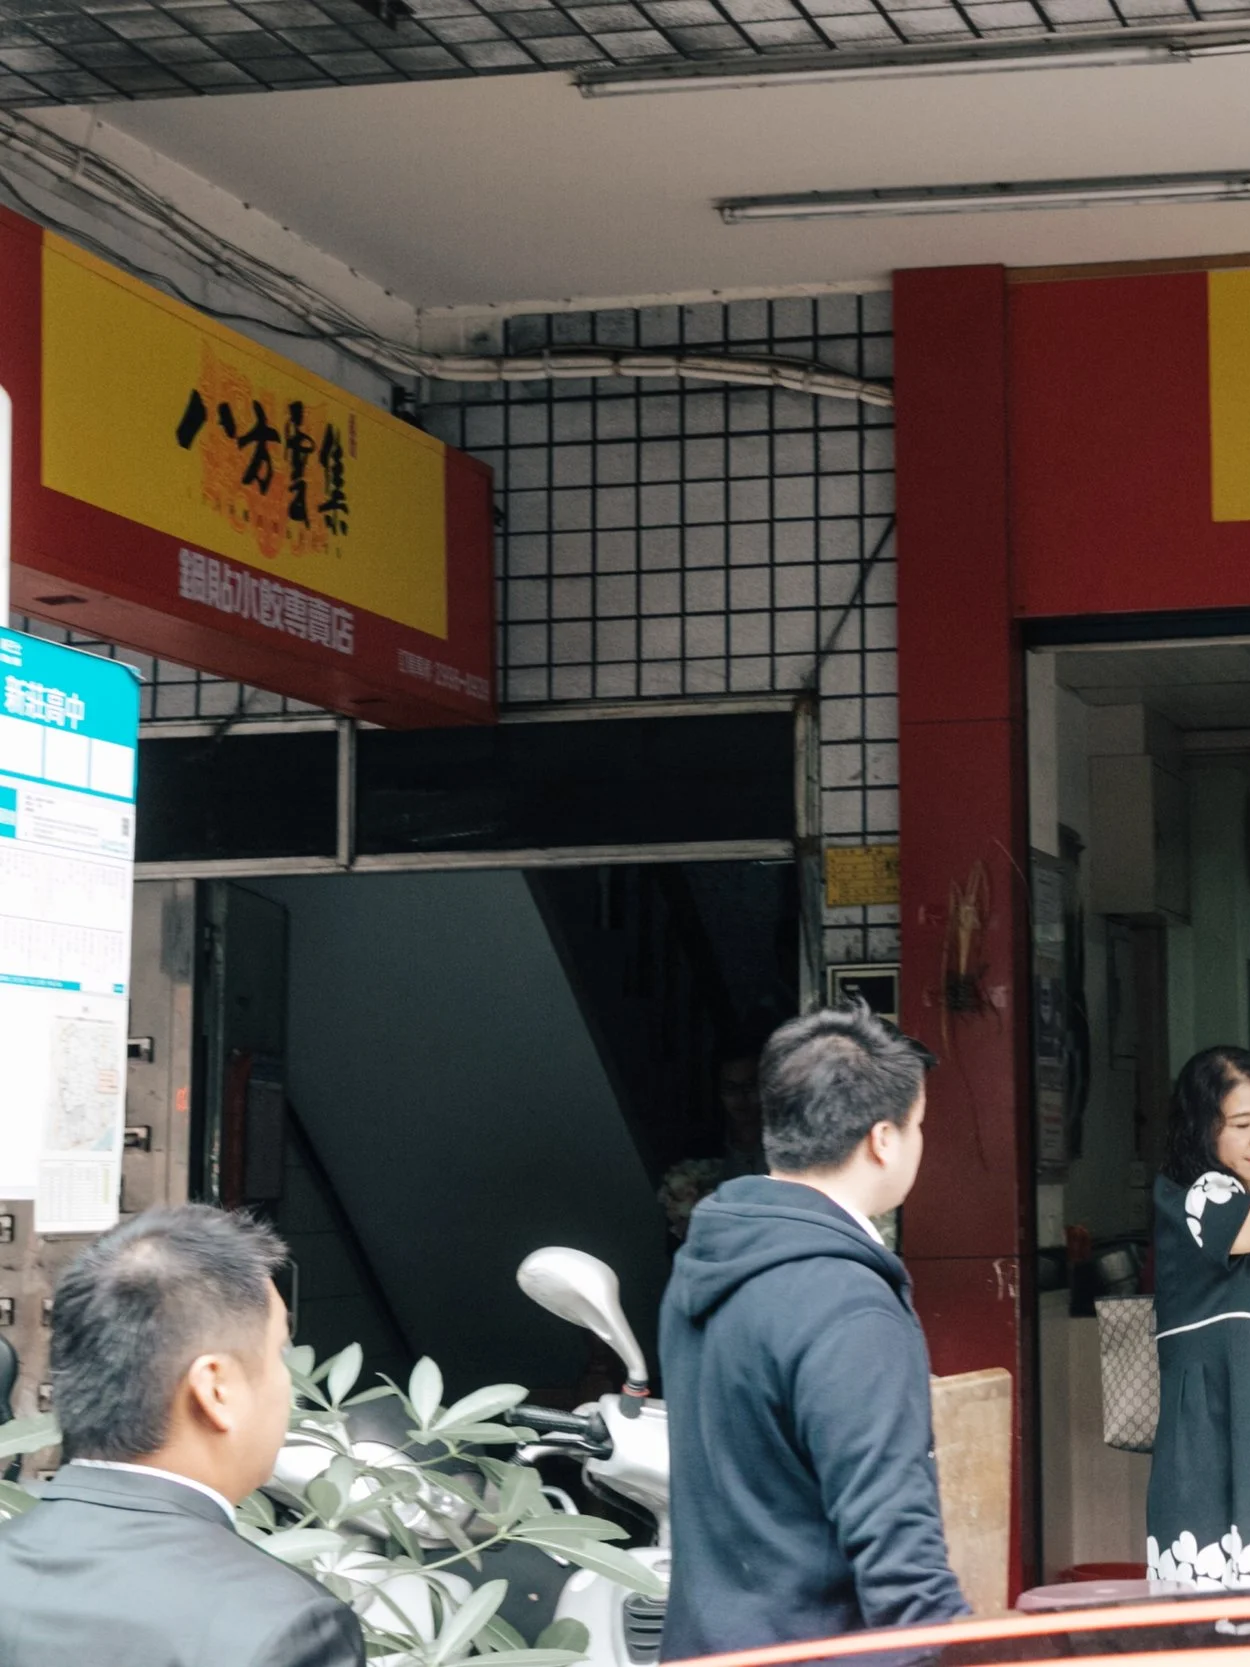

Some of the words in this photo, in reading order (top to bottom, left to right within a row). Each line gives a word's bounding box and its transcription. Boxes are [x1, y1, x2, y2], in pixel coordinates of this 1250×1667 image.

[176, 388, 348, 537] 八方雲集
[180, 547, 354, 655] 鍋貼水餃專賣店
[4, 674, 86, 730] 新莊高中
